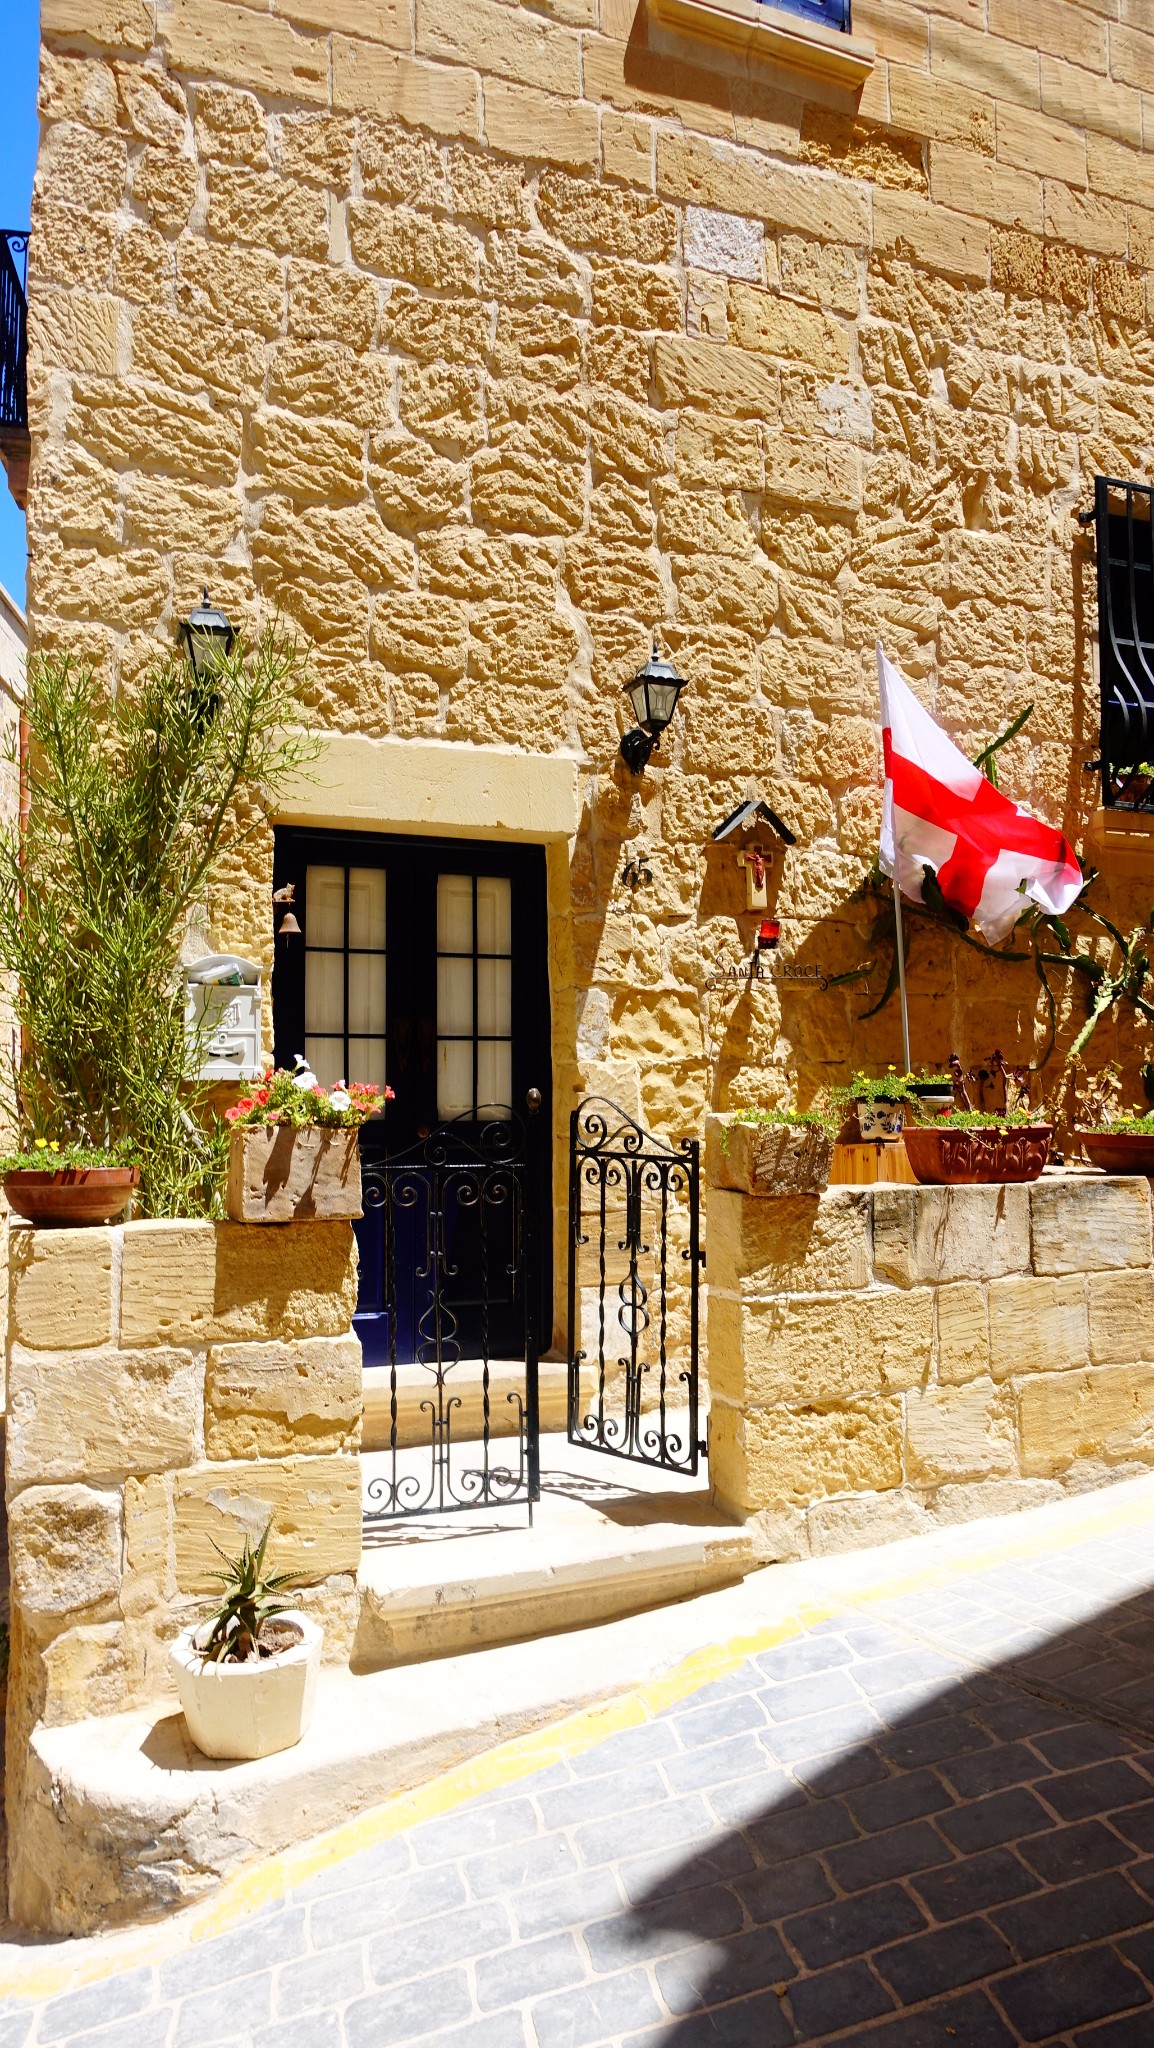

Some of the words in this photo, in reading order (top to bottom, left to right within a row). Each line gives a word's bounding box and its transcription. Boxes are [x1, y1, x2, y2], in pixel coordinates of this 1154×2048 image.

[621, 857, 653, 887] 65
[709, 955, 764, 979] SANTA
[770, 963, 823, 979] CROCE
